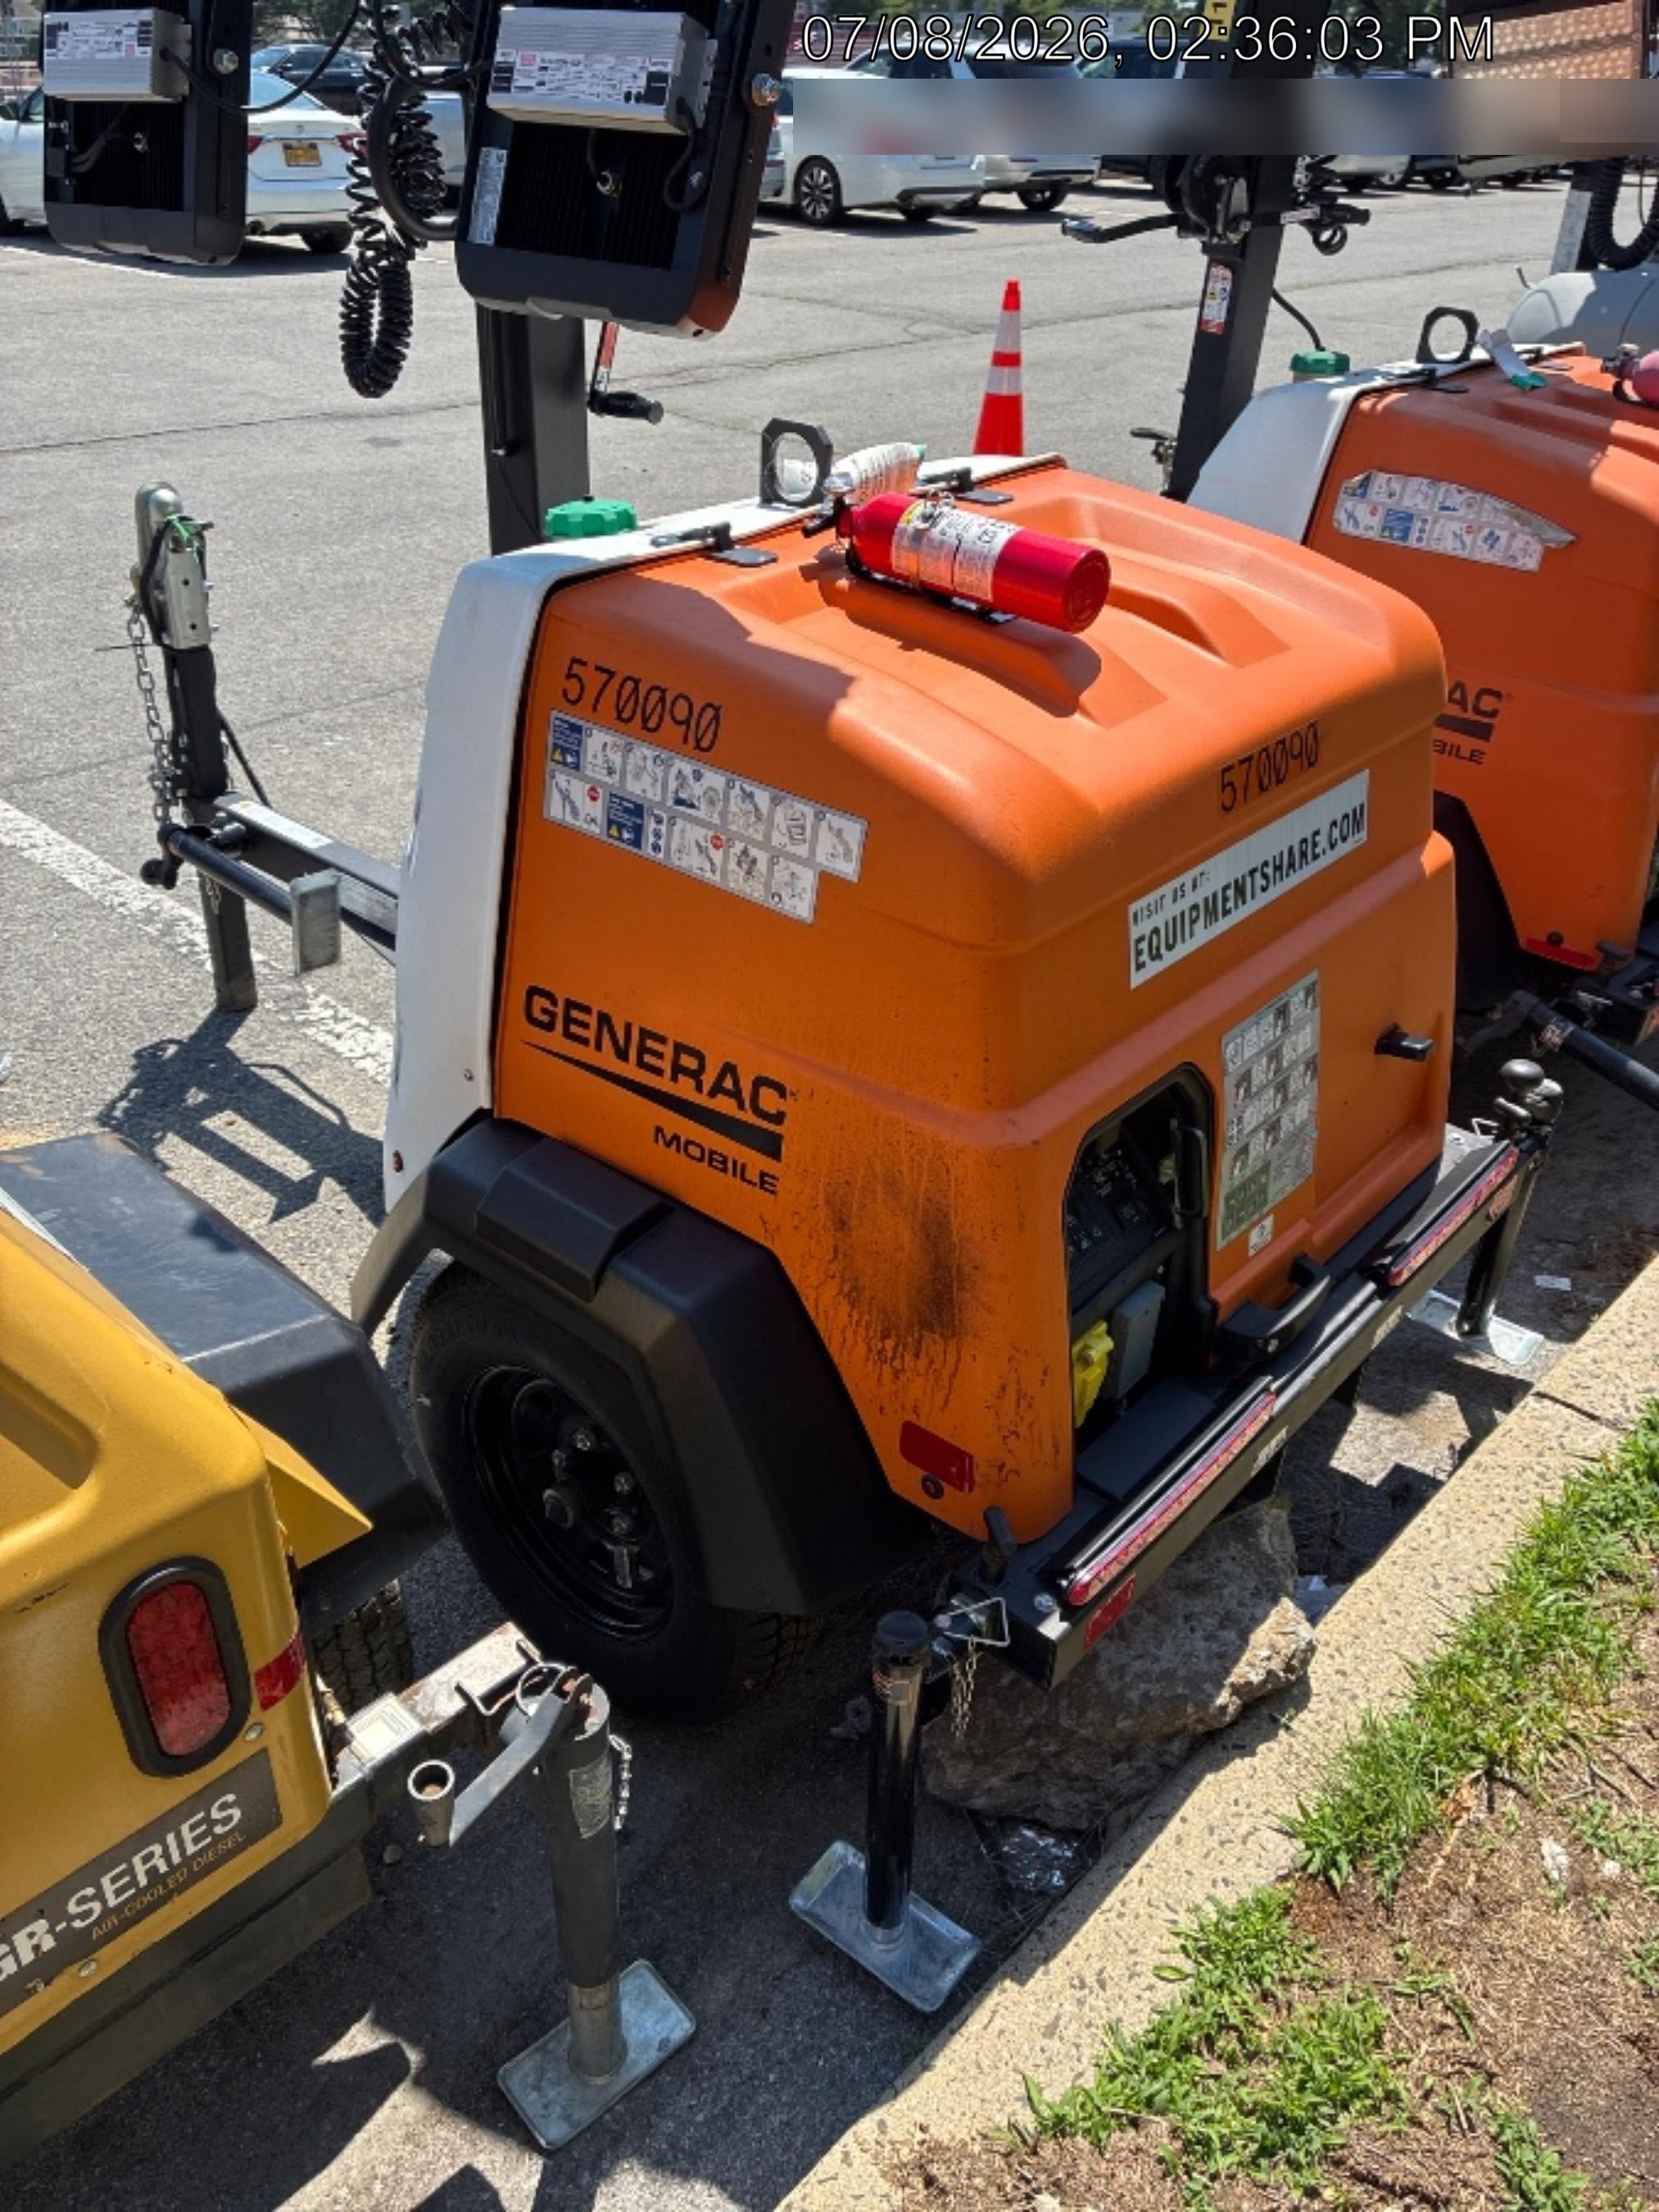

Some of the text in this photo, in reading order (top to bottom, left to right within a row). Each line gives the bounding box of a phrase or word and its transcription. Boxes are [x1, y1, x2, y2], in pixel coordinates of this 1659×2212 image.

[562, 657, 723, 752] 570090
[1220, 719, 1320, 813] 570090
[1134, 802, 1366, 972] EQUIPMENTSHARE.COM
[524, 984, 788, 1127] GENERAC
[653, 1125, 780, 1196] MOBILE
[193, 1831, 246, 1872] DIESEL
